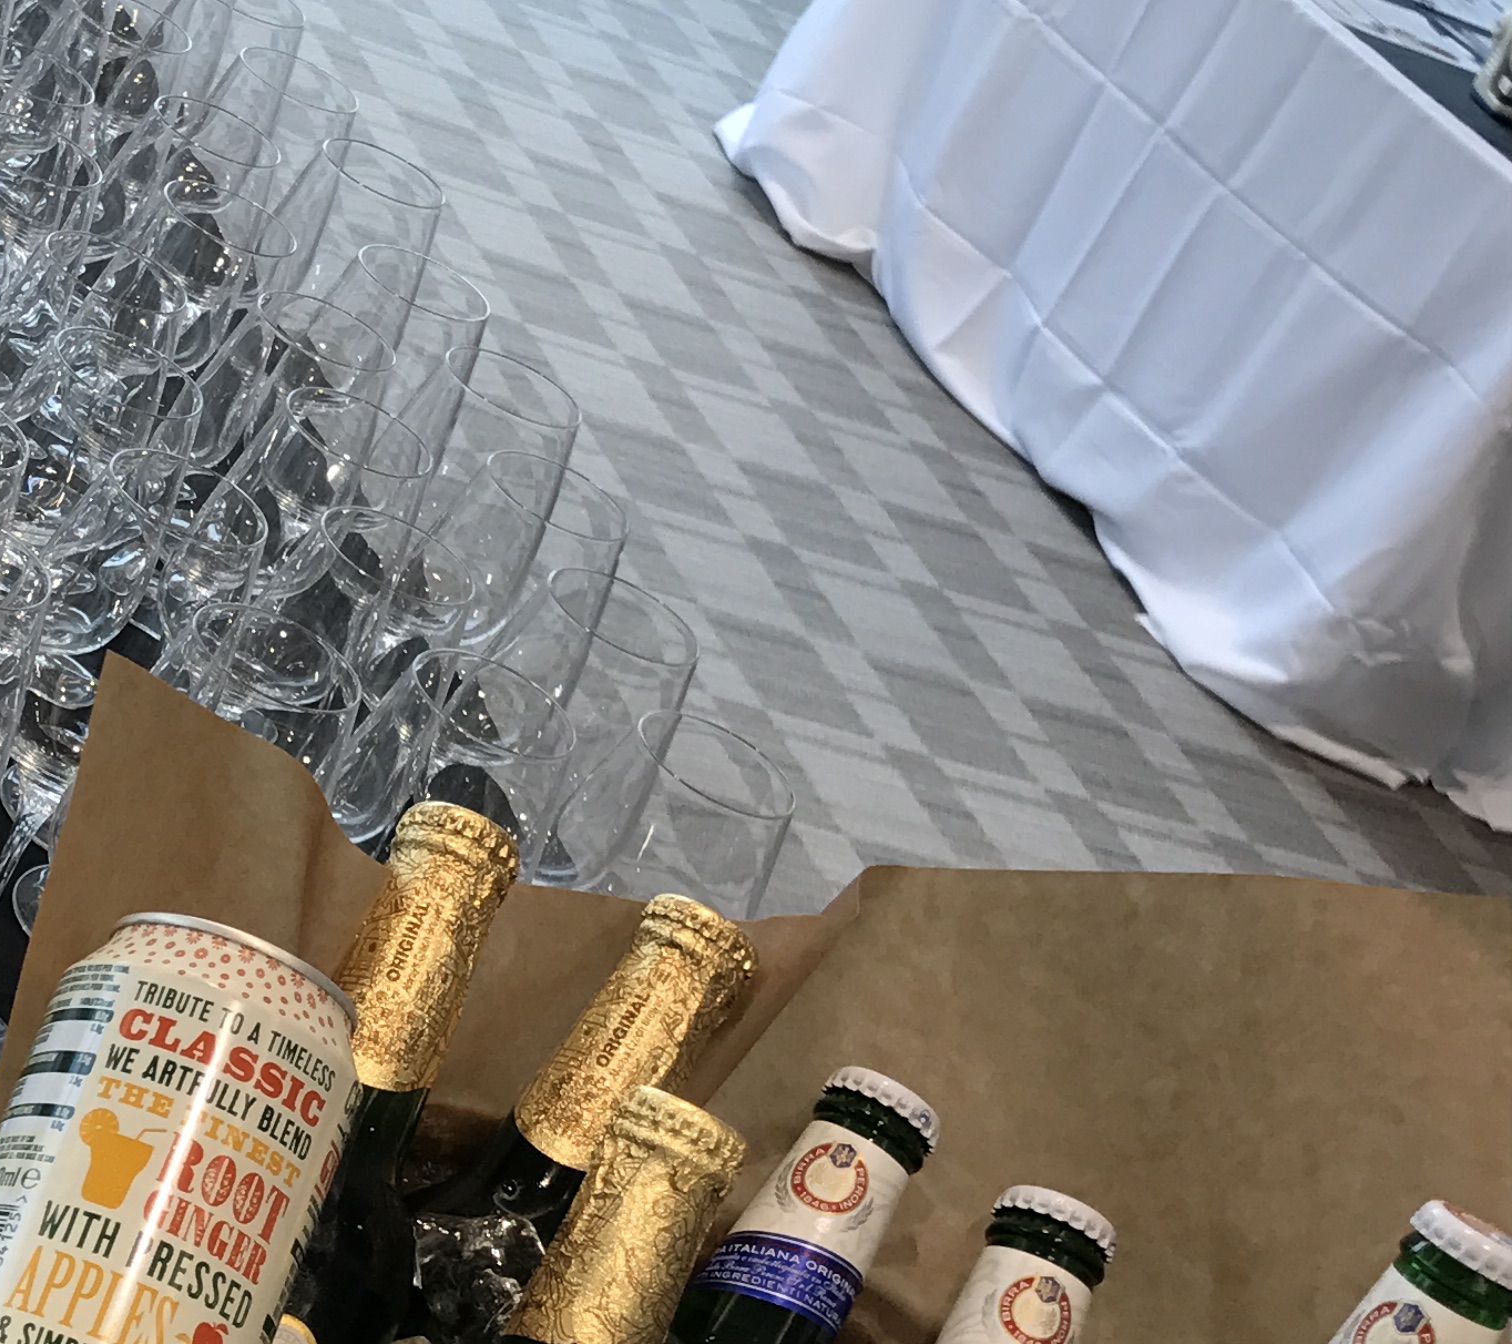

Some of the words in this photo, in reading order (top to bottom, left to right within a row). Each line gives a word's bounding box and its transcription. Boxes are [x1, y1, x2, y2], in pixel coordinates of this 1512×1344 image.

[386, 903, 431, 982] ORIGINAL
[119, 1008, 326, 1127] CLASSIC
[135, 980, 214, 1022] TRIBUTE
[219, 1007, 245, 1035] TO
[247, 1022, 262, 1044] A
[267, 1030, 337, 1093] TIMELESS
[596, 994, 651, 1068] ORIGINAL
[98, 1075, 175, 1119] THE
[105, 1043, 141, 1074] WE
[142, 1054, 257, 1122] ARTFULLY
[257, 1104, 313, 1161] BLEND
[156, 1131, 290, 1244] ROOT
[38, 1199, 122, 1259] WITH
[125, 1230, 253, 1329] PRESSED
[143, 1189, 268, 1285] GINGER
[727, 1243, 801, 1265] ITALIANA
[709, 1270, 801, 1299] INGREDIENTI
[1001, 1280, 1030, 1322] BIRRA
